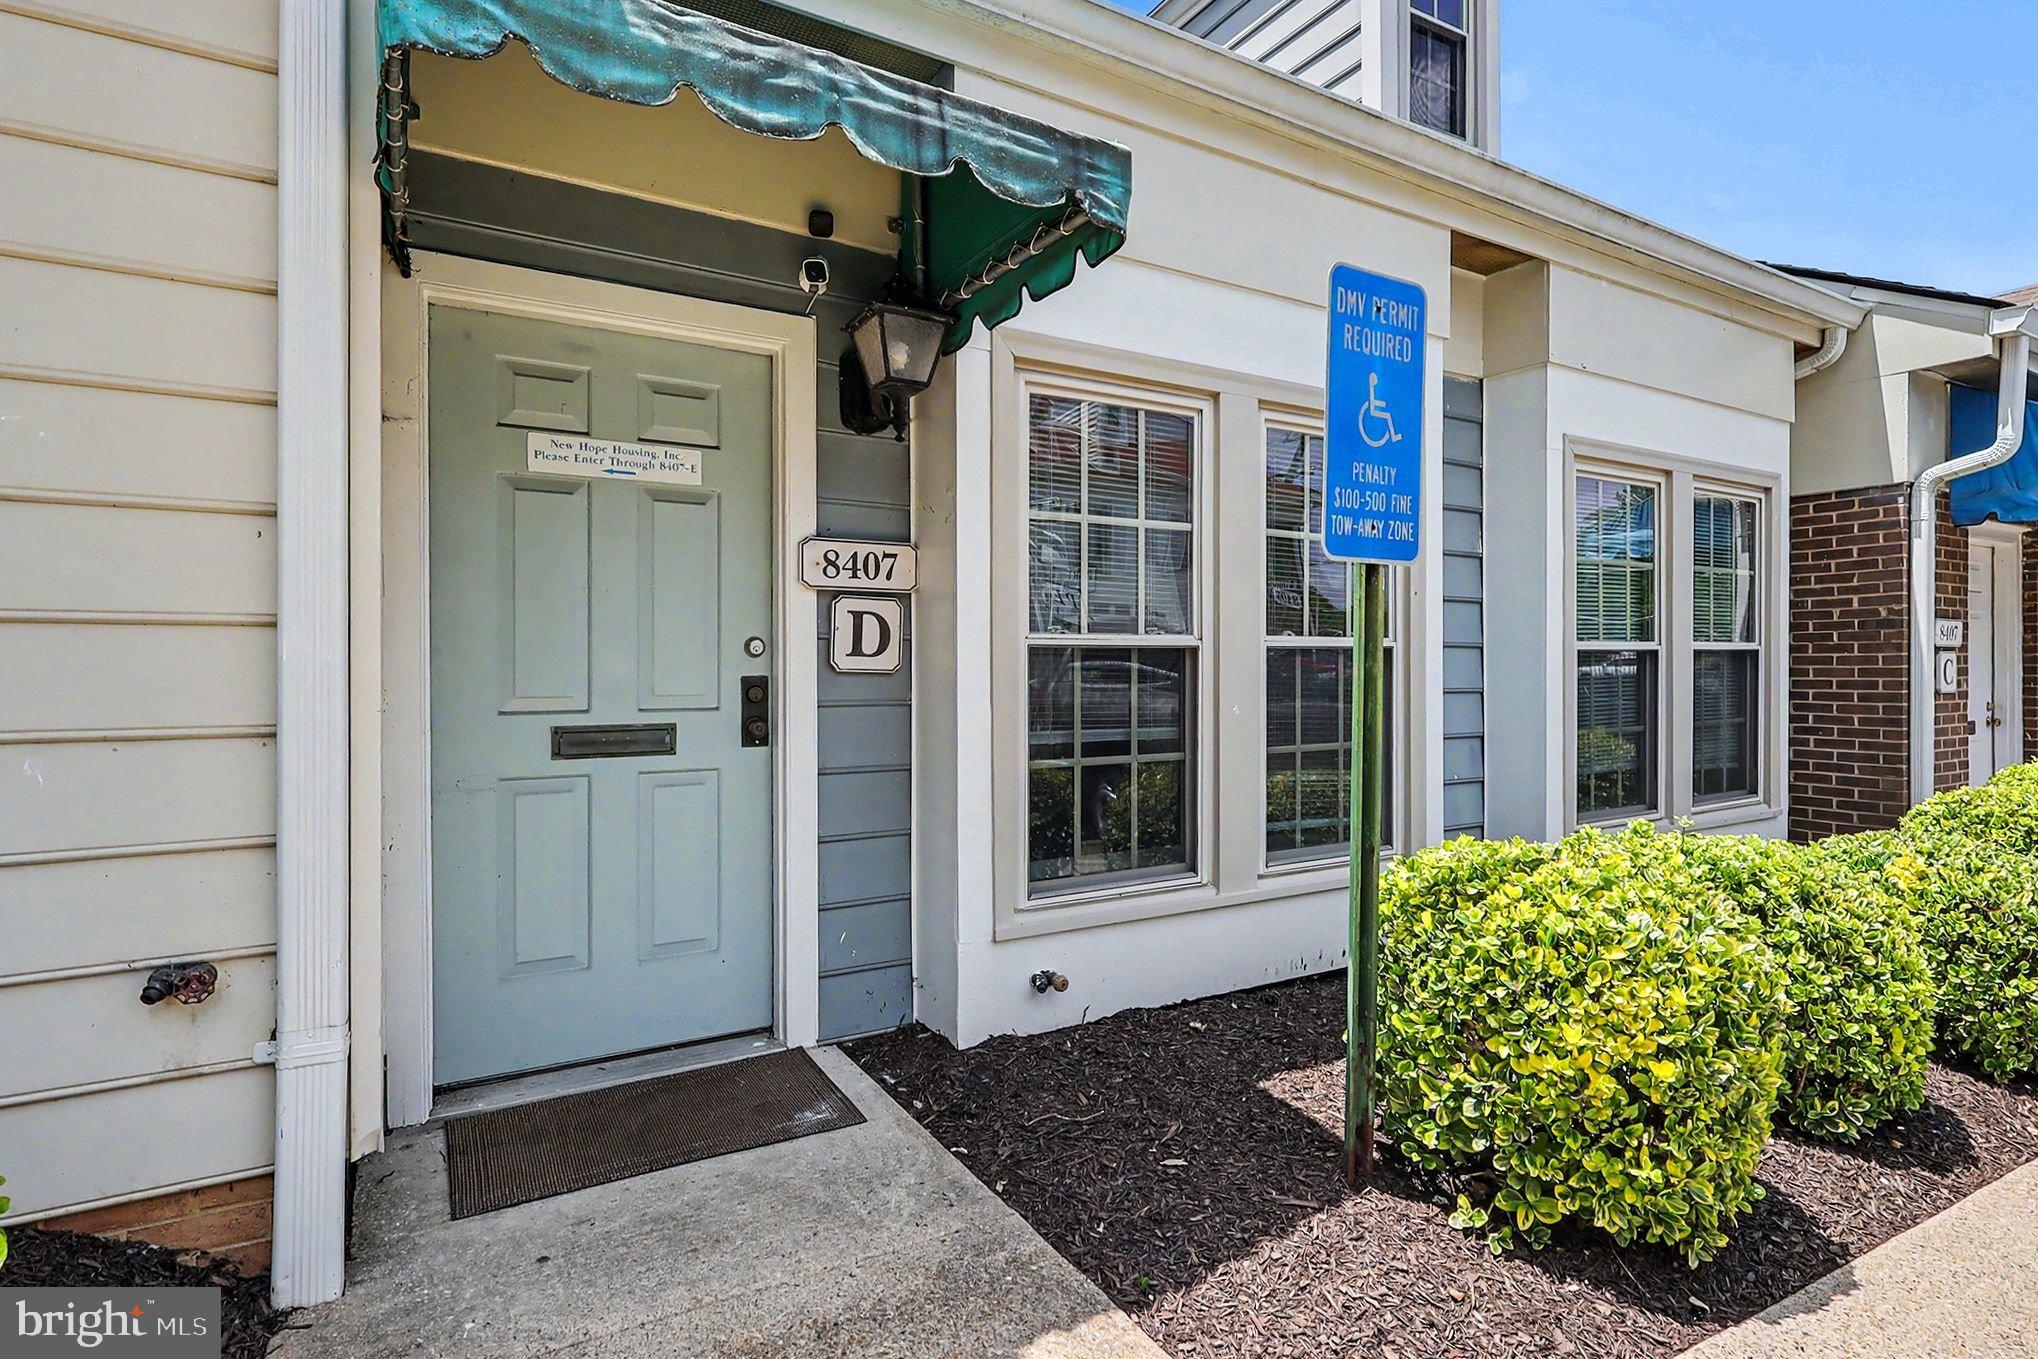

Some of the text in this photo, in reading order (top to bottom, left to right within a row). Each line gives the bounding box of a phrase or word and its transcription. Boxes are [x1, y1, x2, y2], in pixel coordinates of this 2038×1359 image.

[1337, 286, 1420, 332] DMV PERMIT
[1344, 323, 1411, 362] REQUIRED
[534, 450, 697, 473] Please Enter Through 8407-E
[550, 439, 684, 461] New Hope Housing, Inc.
[1352, 461, 1397, 486] PENALTY
[1334, 486, 1412, 515] $100-500 FINE
[1331, 514, 1414, 542] TOW-AWAY ZONE
[823, 549, 898, 582] 8407
[845, 610, 891, 657] D
[1940, 624, 1958, 641] 8407
[1943, 658, 1954, 685] C
